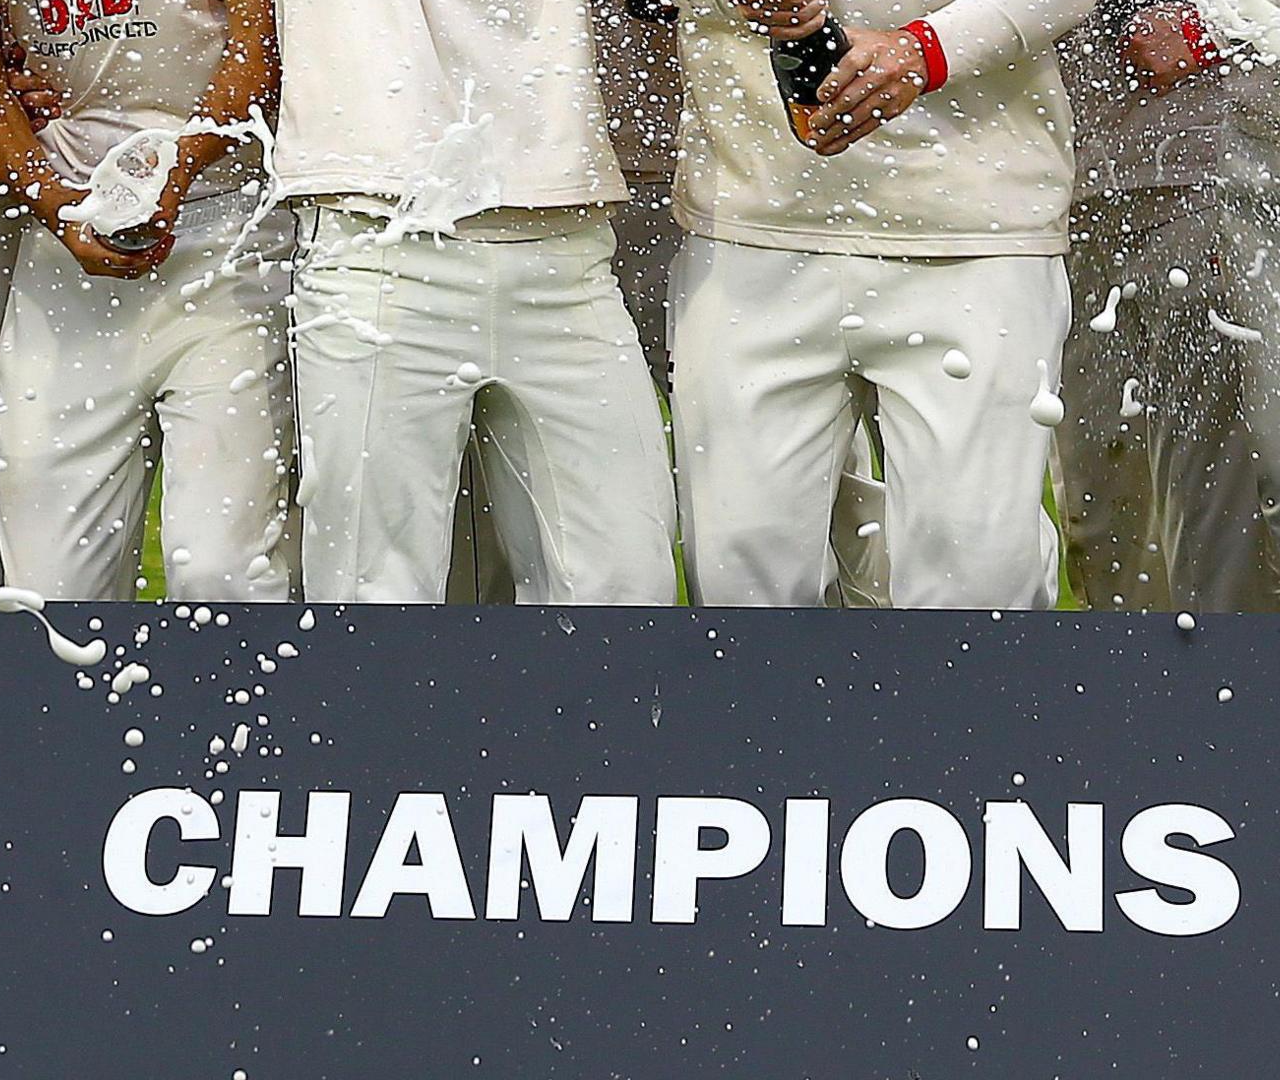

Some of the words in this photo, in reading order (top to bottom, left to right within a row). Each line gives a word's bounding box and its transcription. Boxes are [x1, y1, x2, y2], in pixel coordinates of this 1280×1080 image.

[33, 24, 121, 58] SCAFFDING
[125, 21, 157, 38] LTD
[102, 787, 1241, 937] CHAMPIONS
